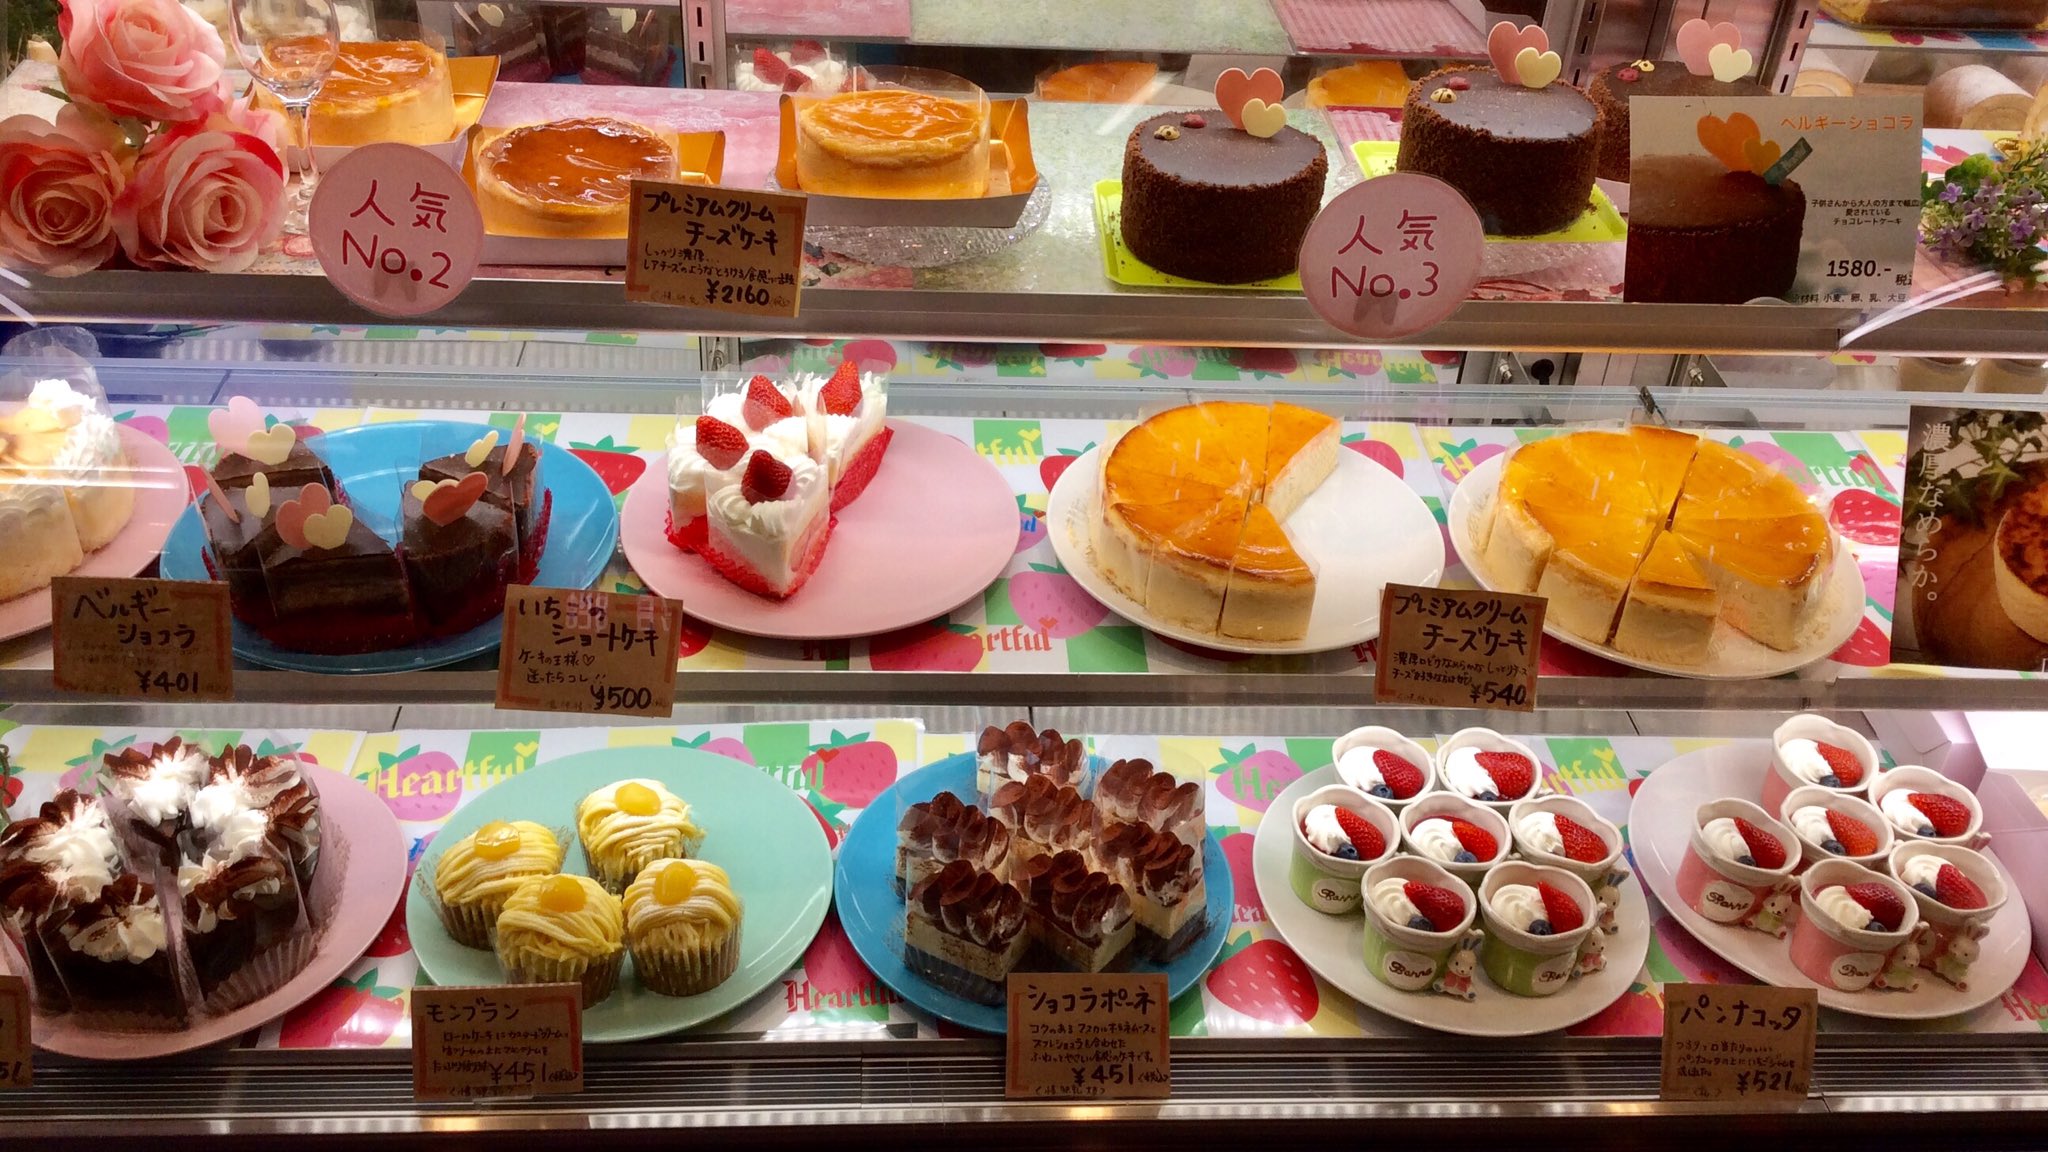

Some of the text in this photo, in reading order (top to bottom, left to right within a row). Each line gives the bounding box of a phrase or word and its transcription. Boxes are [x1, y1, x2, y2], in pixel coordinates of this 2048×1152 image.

[350, 179, 450, 233] 人気
[644, 191, 775, 223] プレミアムクリーム
[686, 221, 778, 256] チーズケーキ
[1338, 209, 1437, 255] 人気
[342, 229, 451, 289] No.2
[1826, 260, 1891, 277] 1580.-
[705, 279, 769, 305] ¥2160
[1331, 261, 1439, 299] No.3
[1911, 423, 1951, 601] 濃厚なめらか。
[73, 586, 171, 622] ベルギー
[1395, 593, 1528, 625] プレミアムクリーム
[117, 623, 196, 648] ショコラ
[552, 622, 660, 657] ショートケーキ
[1423, 623, 1528, 657] チーズケーキ
[134, 670, 199, 694] ¥401
[590, 684, 652, 710] ¥500
[1470, 681, 1528, 706] ¥540
[427, 997, 520, 1023] モンブラン
[1028, 984, 1156, 1015] ショコラポーネ
[1680, 994, 1802, 1031] パンナコッタ
[489, 1061, 548, 1084] ¥451
[1072, 1063, 1134, 1087] ¥451
[1736, 1070, 1793, 1096] ¥521
